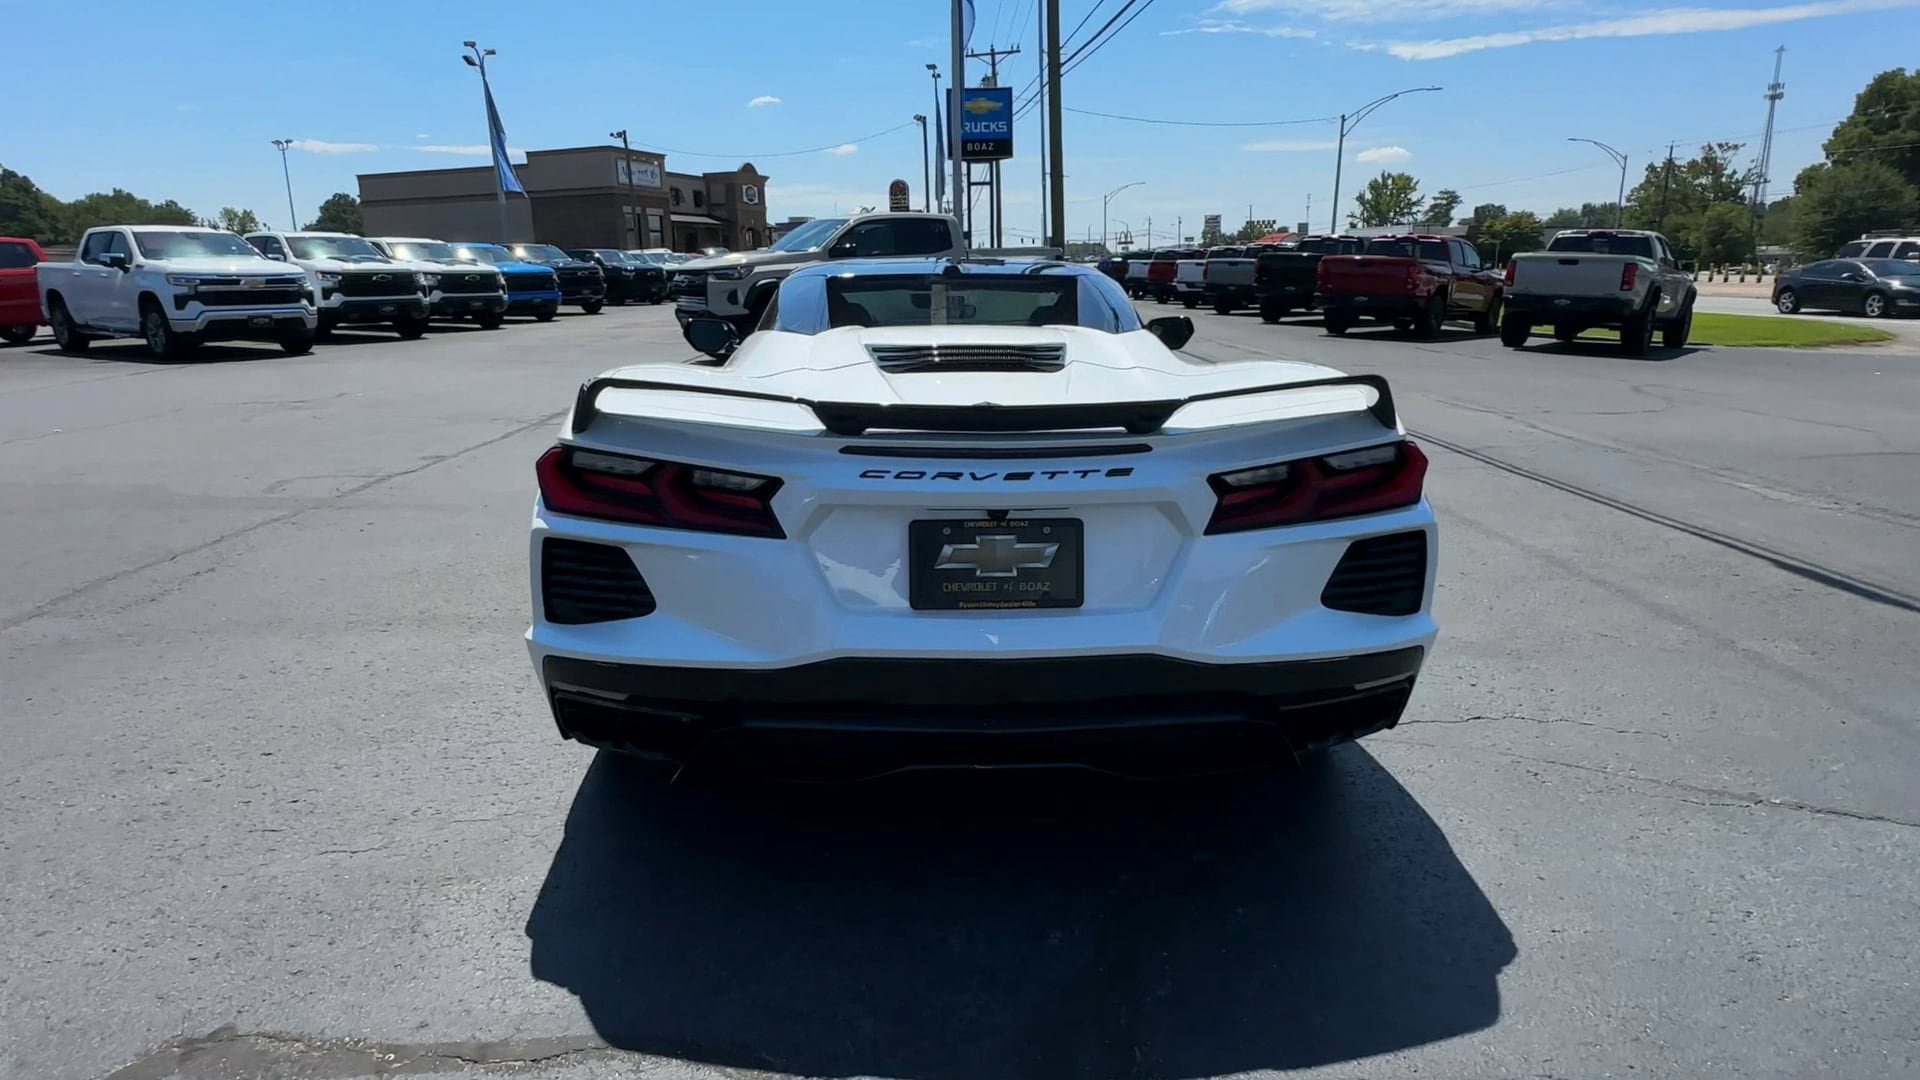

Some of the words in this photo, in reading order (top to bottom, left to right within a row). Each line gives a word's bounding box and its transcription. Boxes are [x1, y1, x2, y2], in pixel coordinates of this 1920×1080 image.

[964, 121, 1007, 133] RUCKS
[967, 142, 994, 151] BOAZ
[859, 467, 1134, 481] CORVETTE
[964, 520, 997, 528] CHEVROLET
[1010, 520, 1029, 528] BOAZ
[943, 582, 997, 592] CHEVROLET
[1020, 582, 1051, 592] BOAZ
